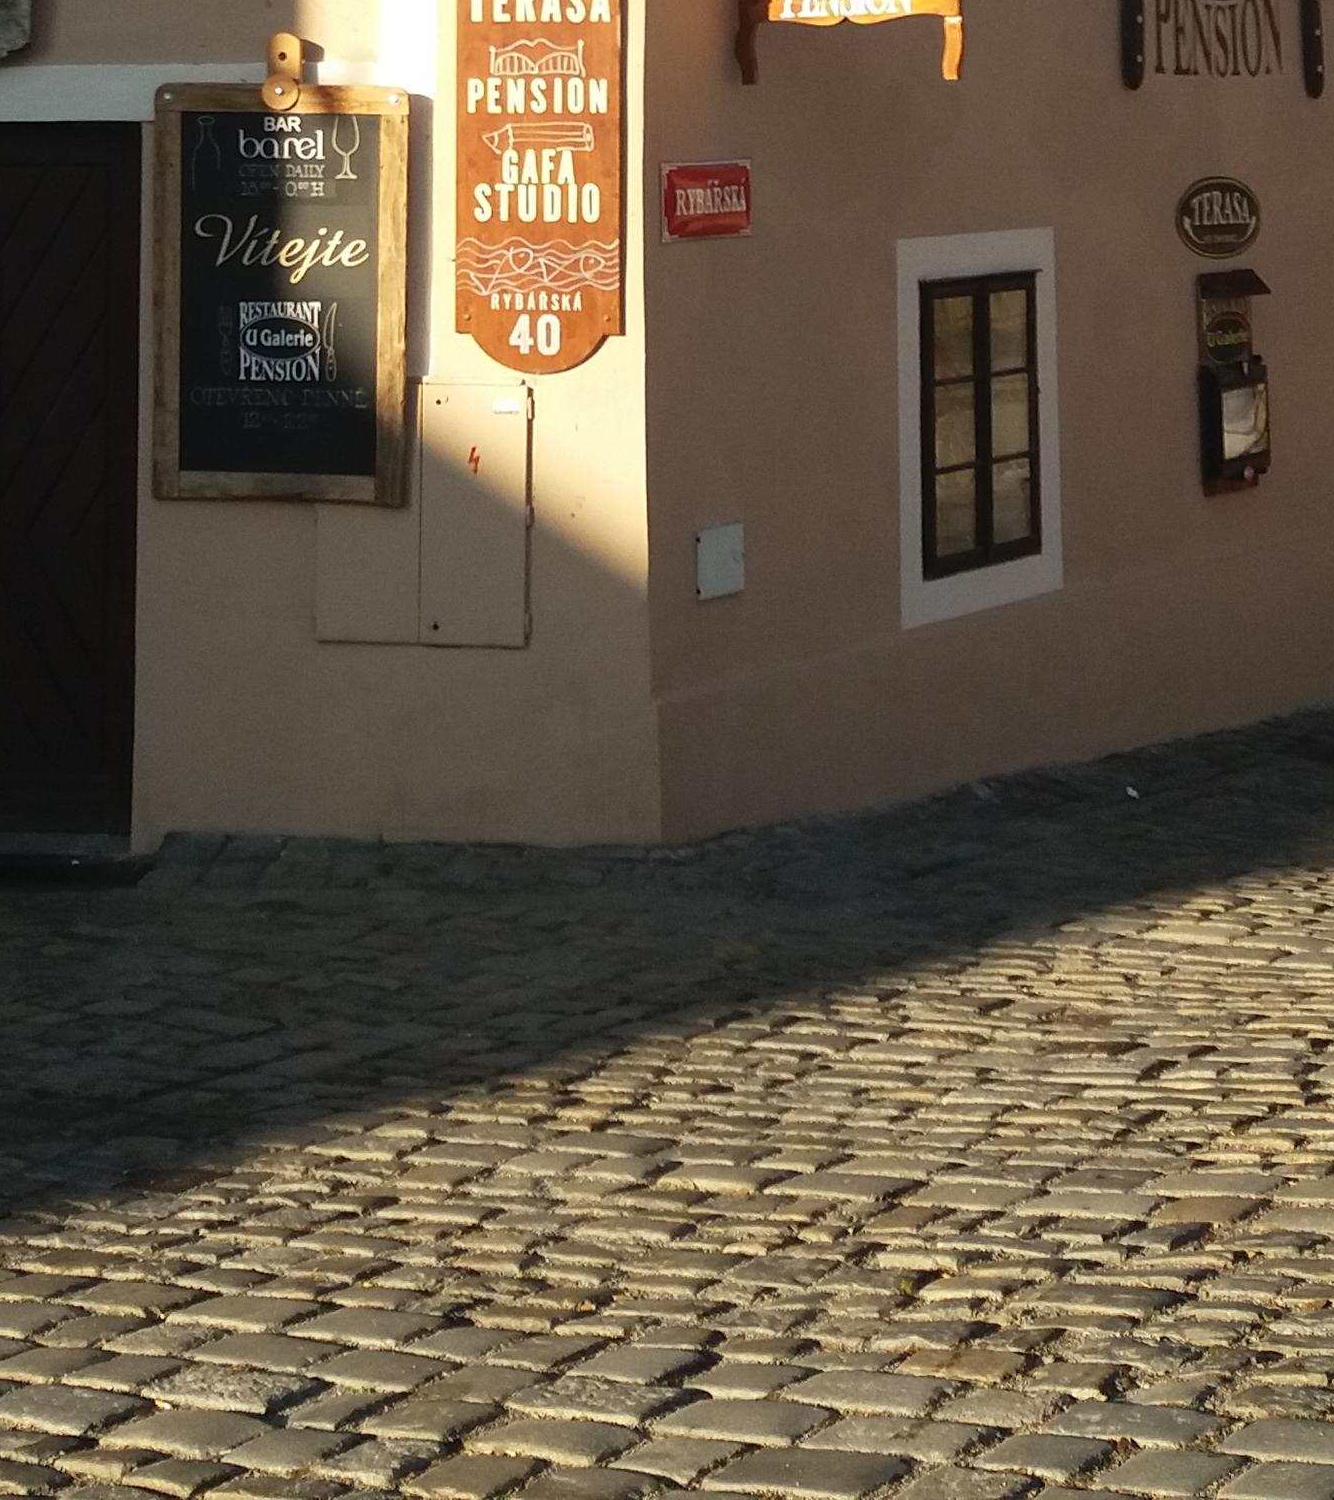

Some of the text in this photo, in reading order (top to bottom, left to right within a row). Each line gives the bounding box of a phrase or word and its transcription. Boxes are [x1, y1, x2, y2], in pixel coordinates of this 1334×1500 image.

[466, 77, 608, 114] PENSION
[263, 115, 302, 133] BAR
[237, 128, 326, 160] barel
[284, 163, 326, 179] DAILY
[501, 148, 576, 185] GAFA
[473, 182, 601, 223] STUDIO
[675, 177, 748, 217] RYBÁŘSKÁ
[1190, 190, 1252, 226] TERASA
[194, 213, 371, 284] Vítejte
[239, 301, 322, 329] RESTAURANT
[245, 327, 314, 348] U Galerie
[508, 313, 562, 356] 40
[239, 350, 321, 382] PENSION
